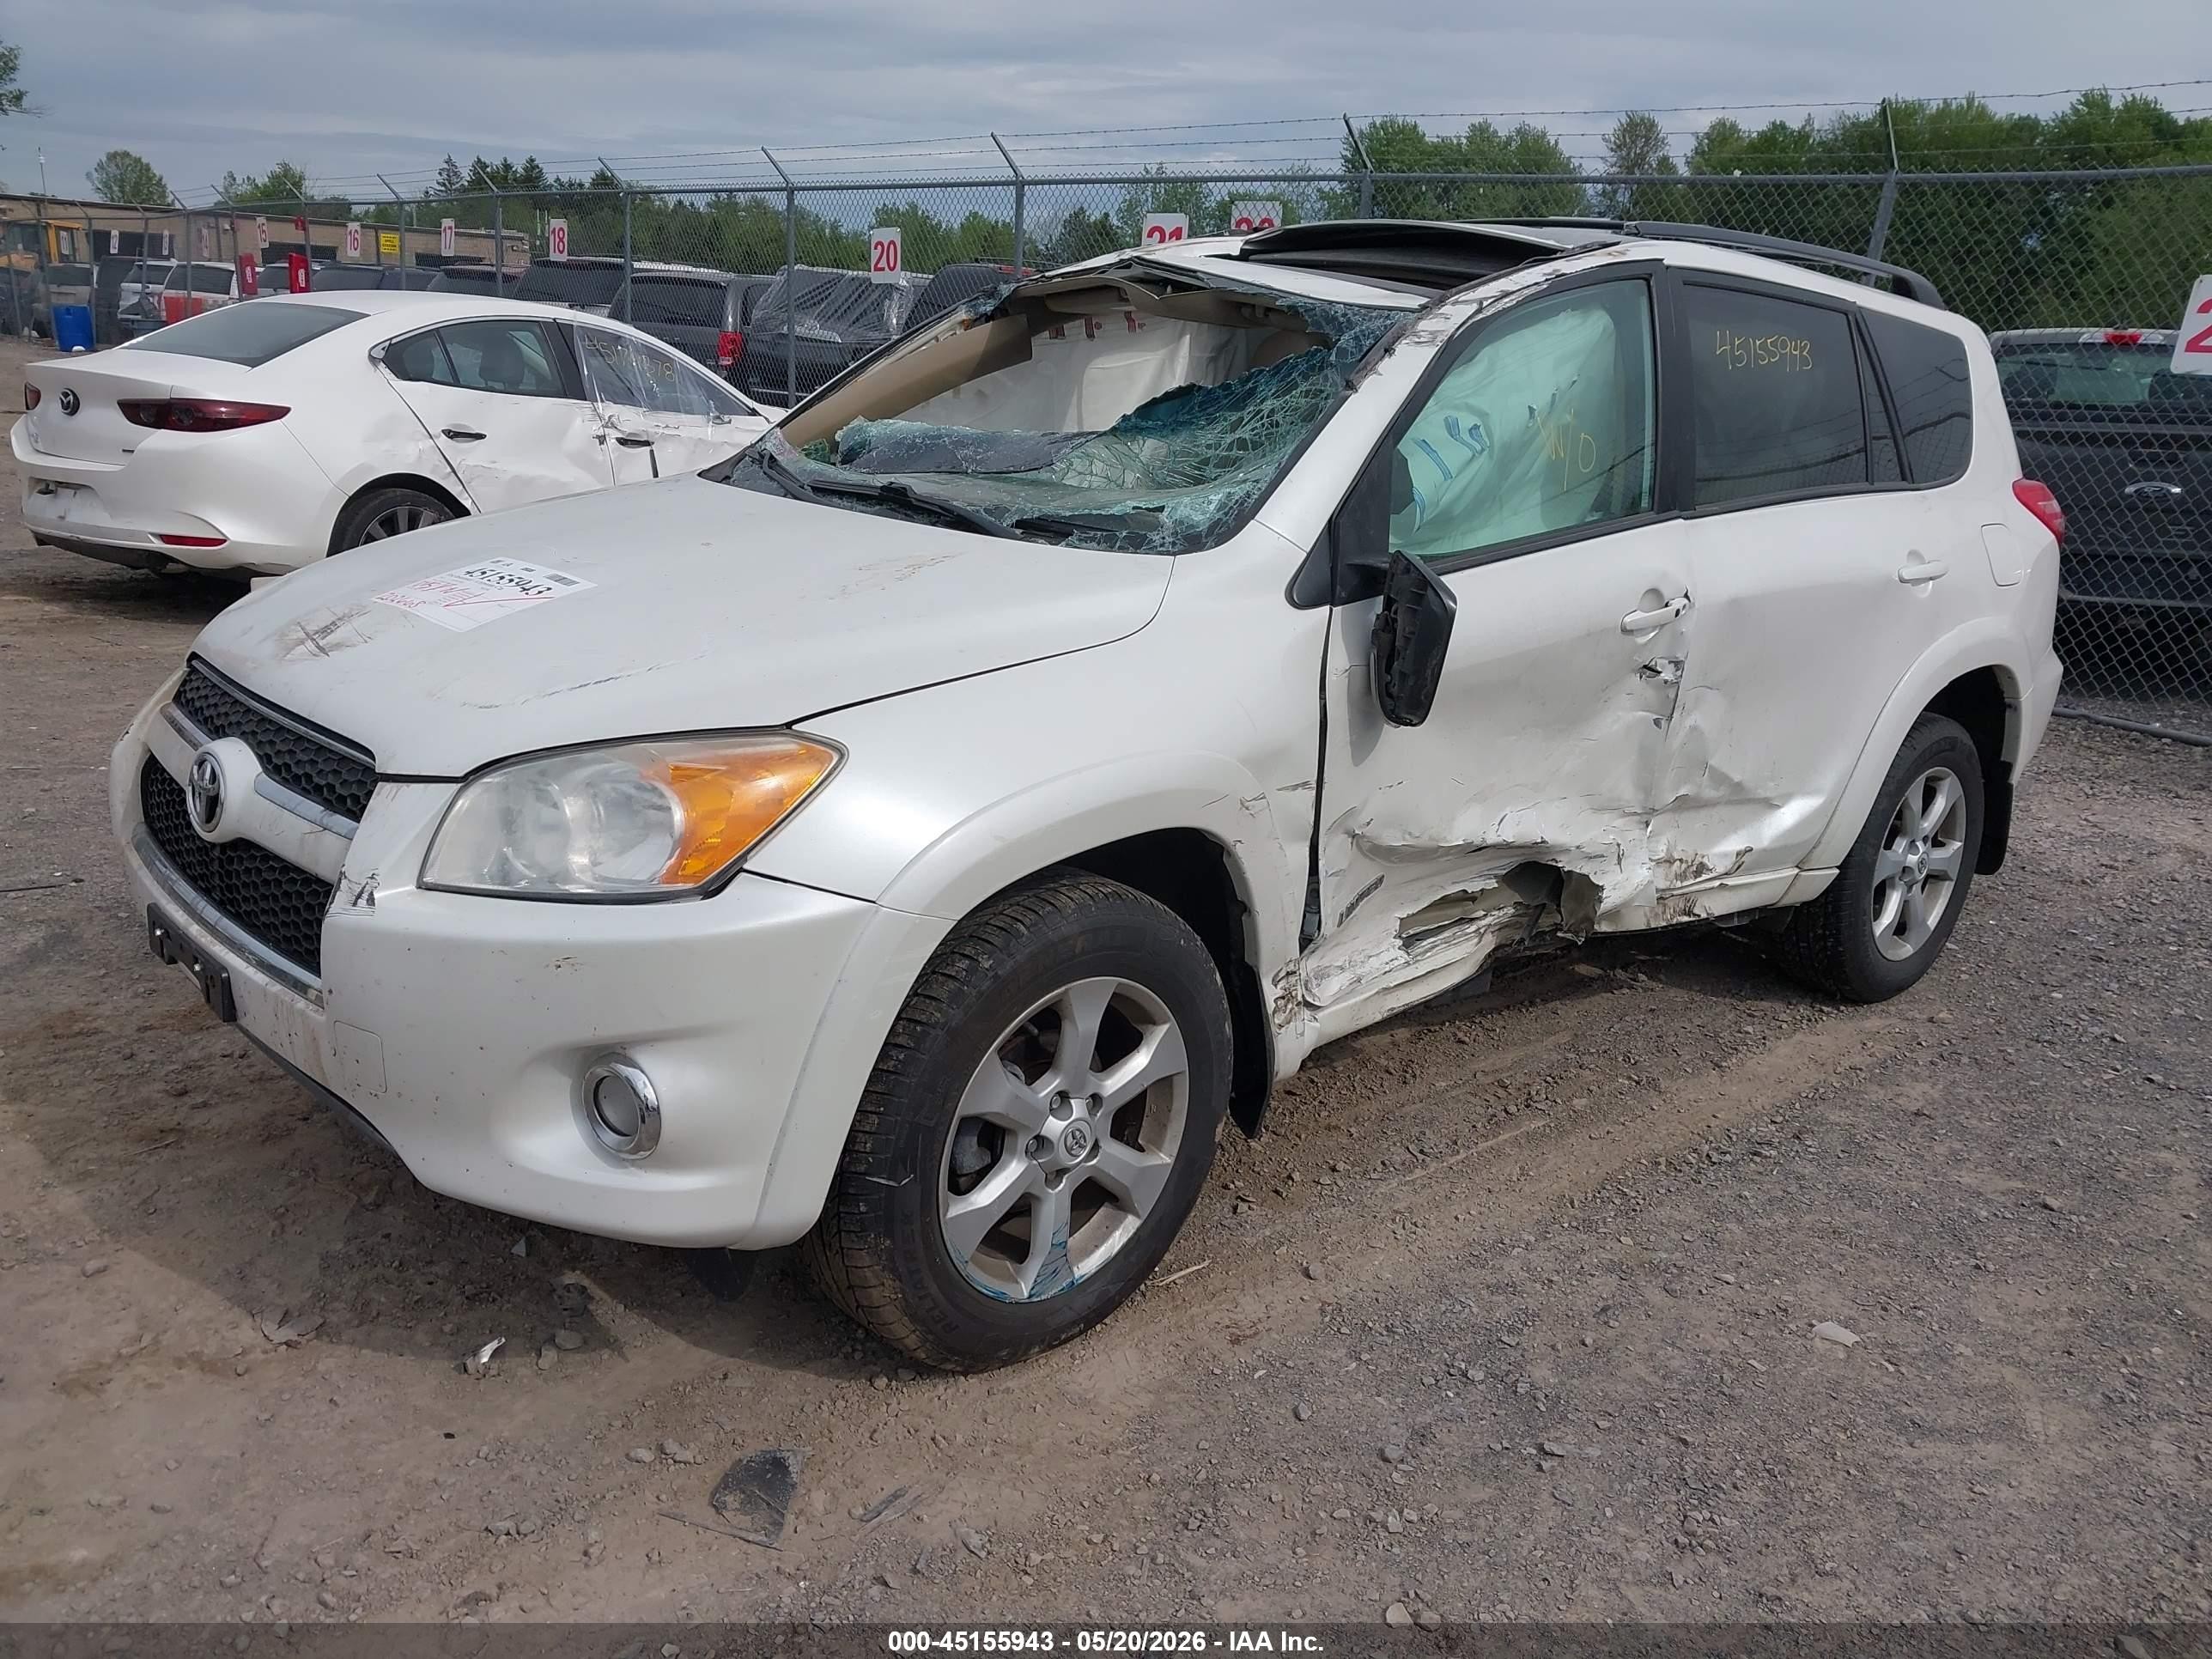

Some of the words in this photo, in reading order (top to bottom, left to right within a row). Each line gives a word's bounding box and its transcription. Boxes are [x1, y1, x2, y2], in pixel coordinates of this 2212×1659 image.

[349, 228, 359, 252] 16
[442, 225, 453, 250] 17
[550, 227, 566, 255] 18
[873, 240, 898, 272] 20
[1716, 330, 1813, 372] 45155943
[464, 567, 554, 596] 45155943
